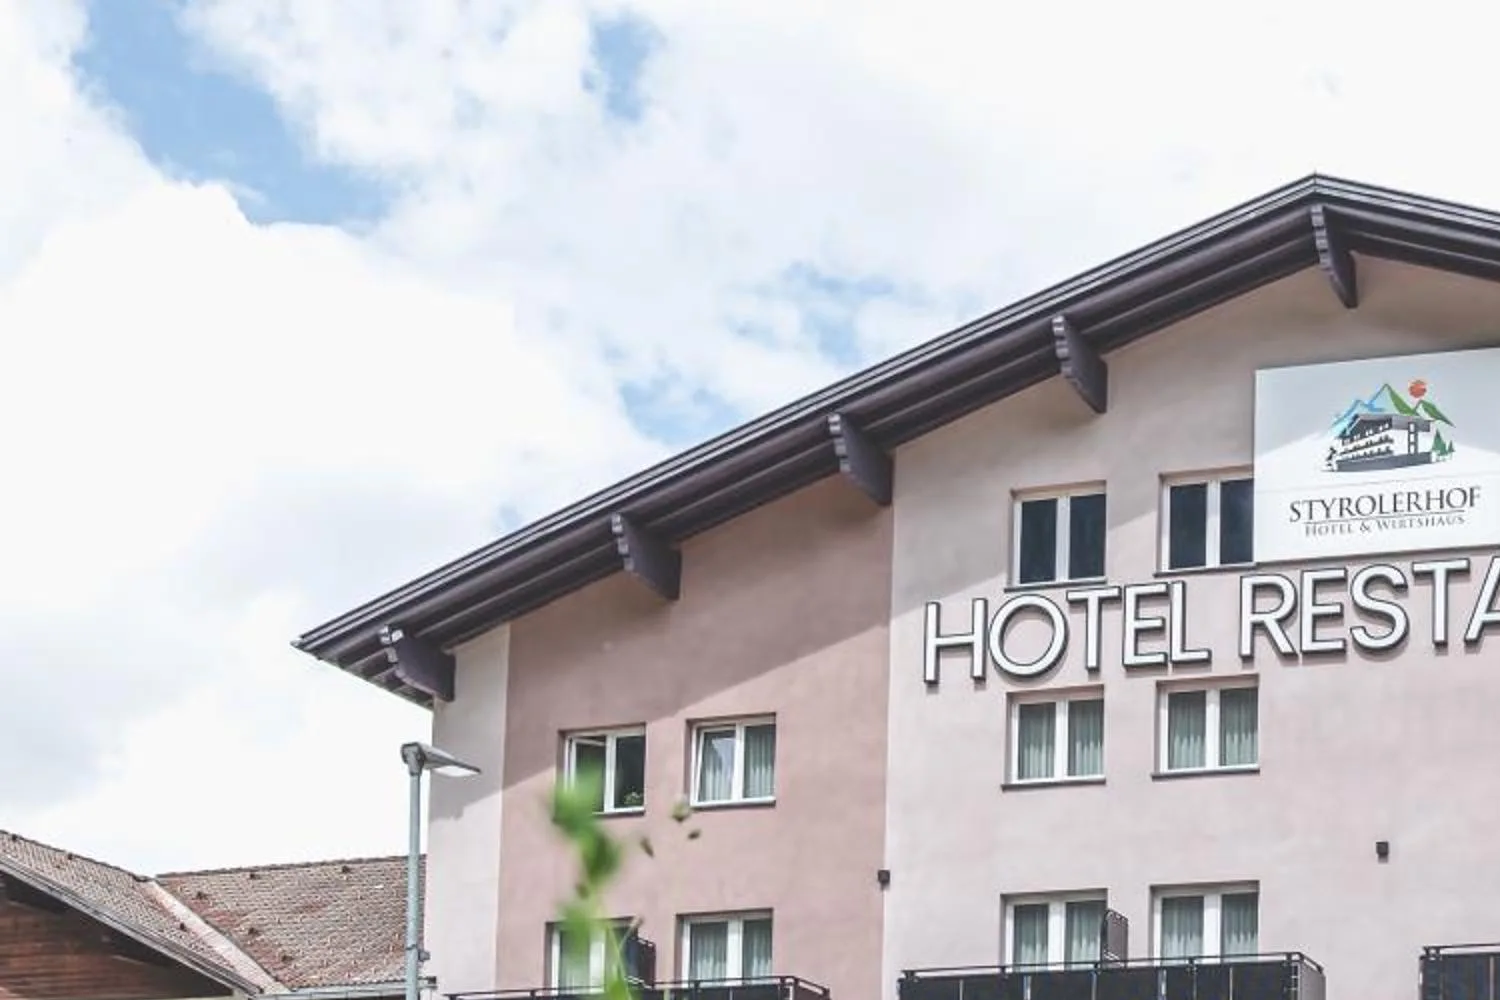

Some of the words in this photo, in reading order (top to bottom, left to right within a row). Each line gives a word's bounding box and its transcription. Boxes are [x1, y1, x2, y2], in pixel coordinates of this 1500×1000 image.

[1289, 486, 1481, 523] STYROLERHOF
[1305, 523, 1353, 538] HOTEL
[1359, 521, 1371, 534] &
[1376, 515, 1466, 532] WIRTSHAUS
[924, 580, 1212, 685] HOTEL
